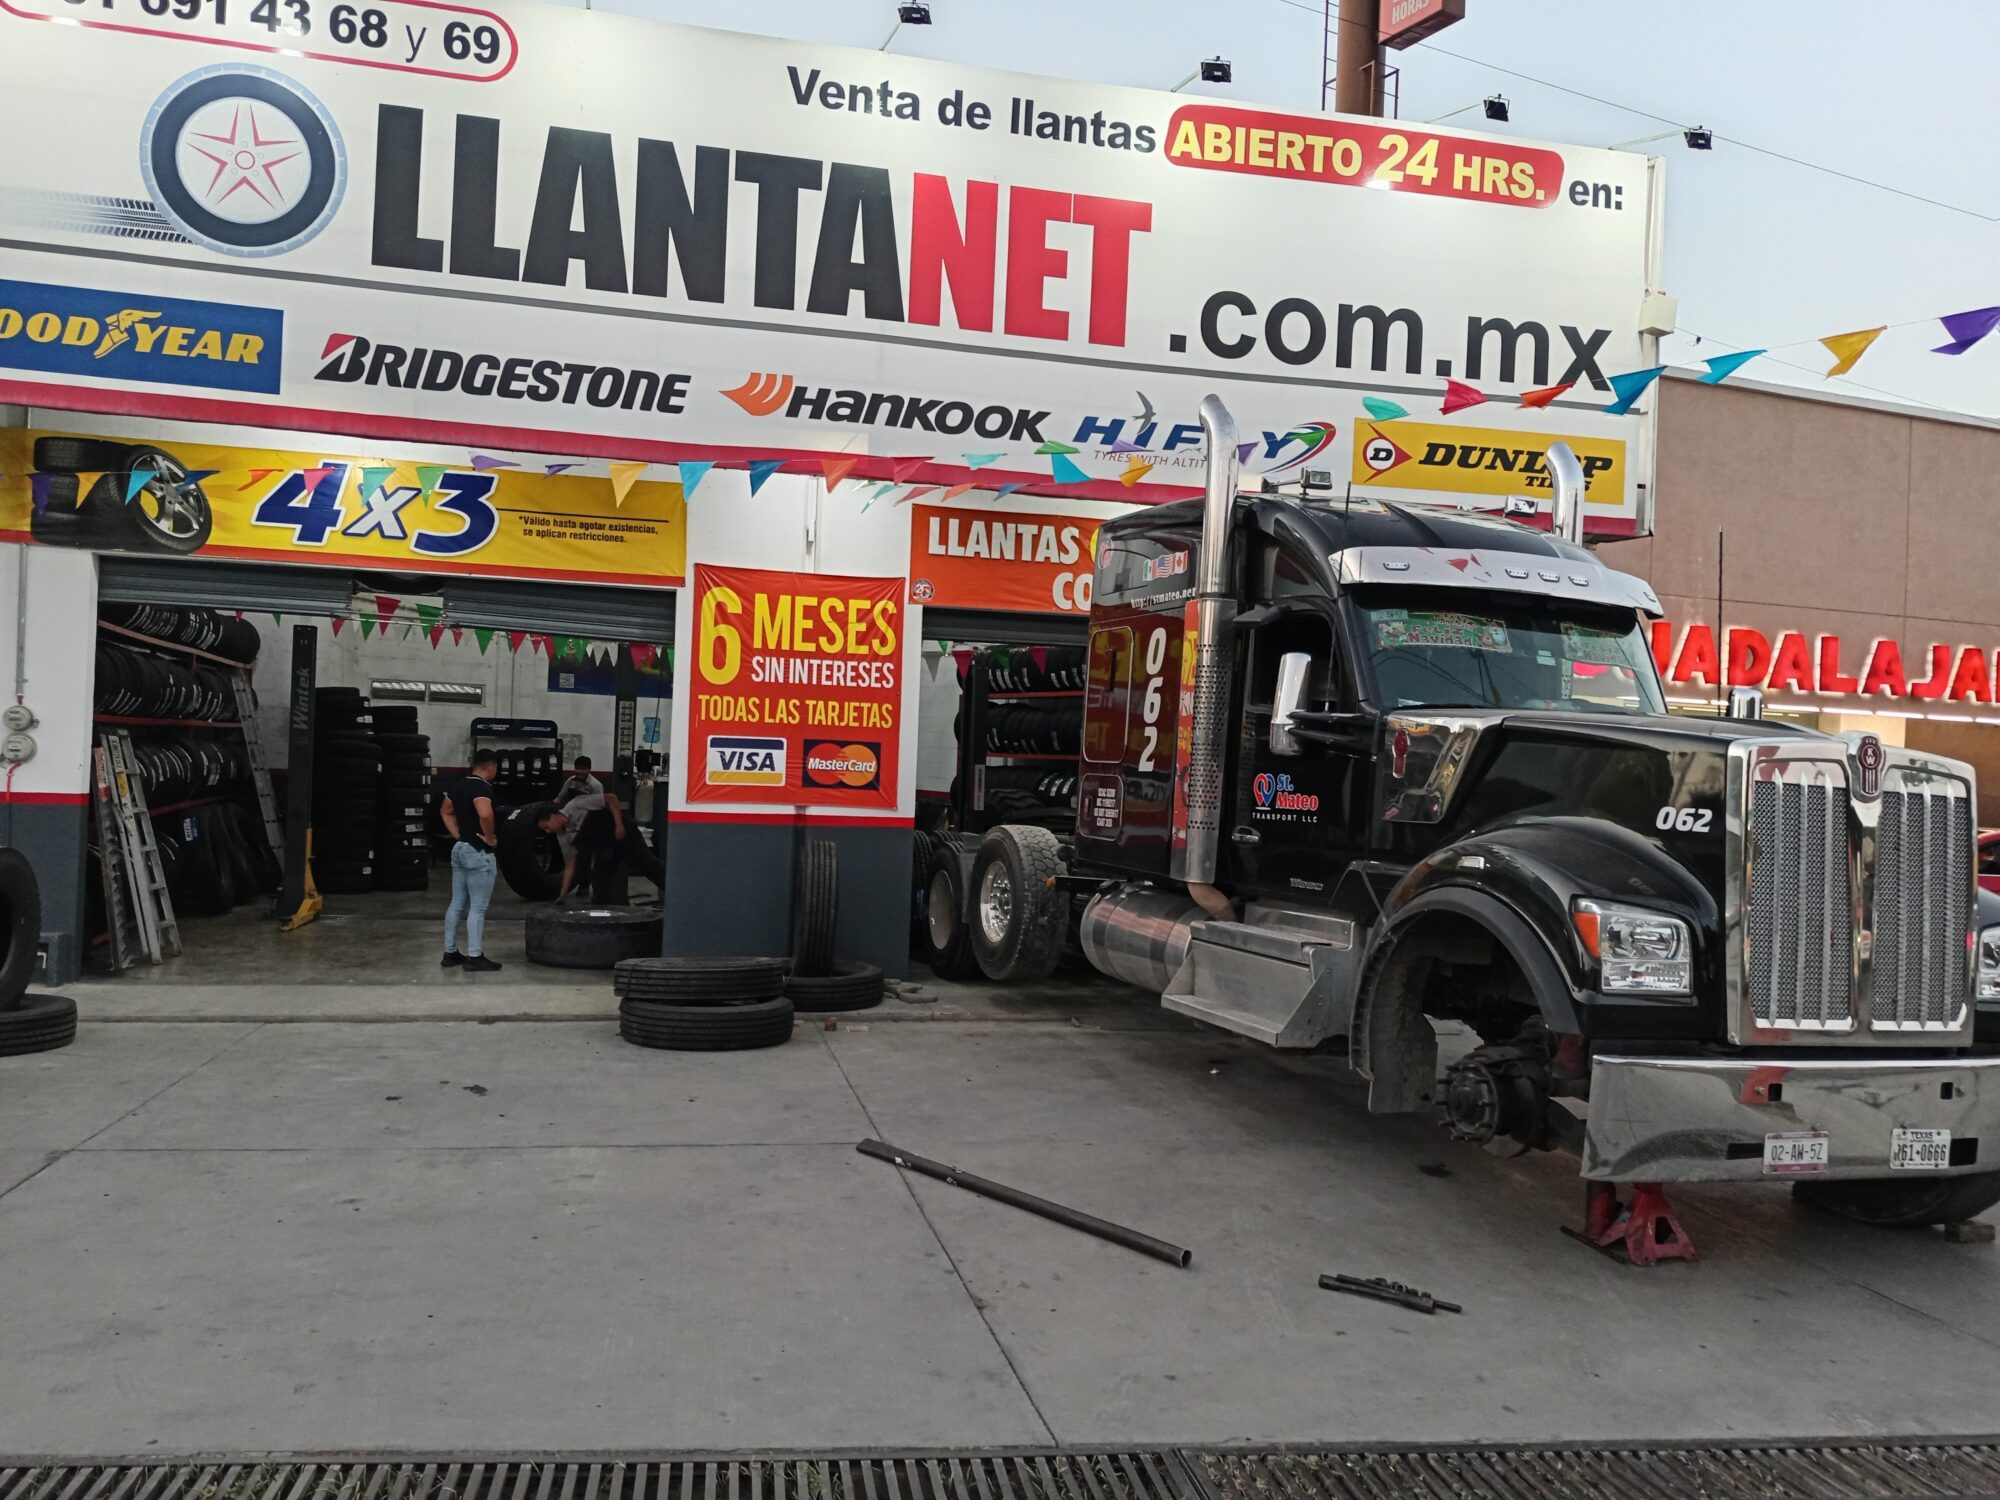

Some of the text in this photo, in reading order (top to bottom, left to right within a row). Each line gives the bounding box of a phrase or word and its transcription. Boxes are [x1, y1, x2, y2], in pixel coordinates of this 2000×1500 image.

[329, 4, 388, 48] 68
[405, 24, 427, 63] y
[443, 21, 500, 64] 69
[786, 65, 1624, 210] Venta de llantas ABIERTO 24 HRS. en:
[371, 103, 1613, 392] LLANTANET .com.mx
[313, 333, 693, 415] BRIDGESTONE
[1072, 415, 1309, 459] HIFY
[1418, 442, 1614, 479] DUNLP
[251, 459, 500, 557] 4x3
[552, 518, 577, 529] hasta
[579, 520, 606, 532] agotar
[522, 528, 628, 544] se aplican restricciones.
[927, 516, 1080, 566] LLANTAS
[698, 586, 898, 686] 6 MESES
[751, 655, 895, 690] SIN INTERESES
[697, 694, 893, 729] TODAS LAS TARJETAS
[1138, 626, 1168, 773] 062
[715, 750, 776, 772] VISA
[807, 756, 877, 774] MasterCard
[1252, 812, 1318, 823] TRANSPORT LLC
[1275, 791, 1319, 812] Mateo
[1655, 805, 1714, 833] 062
